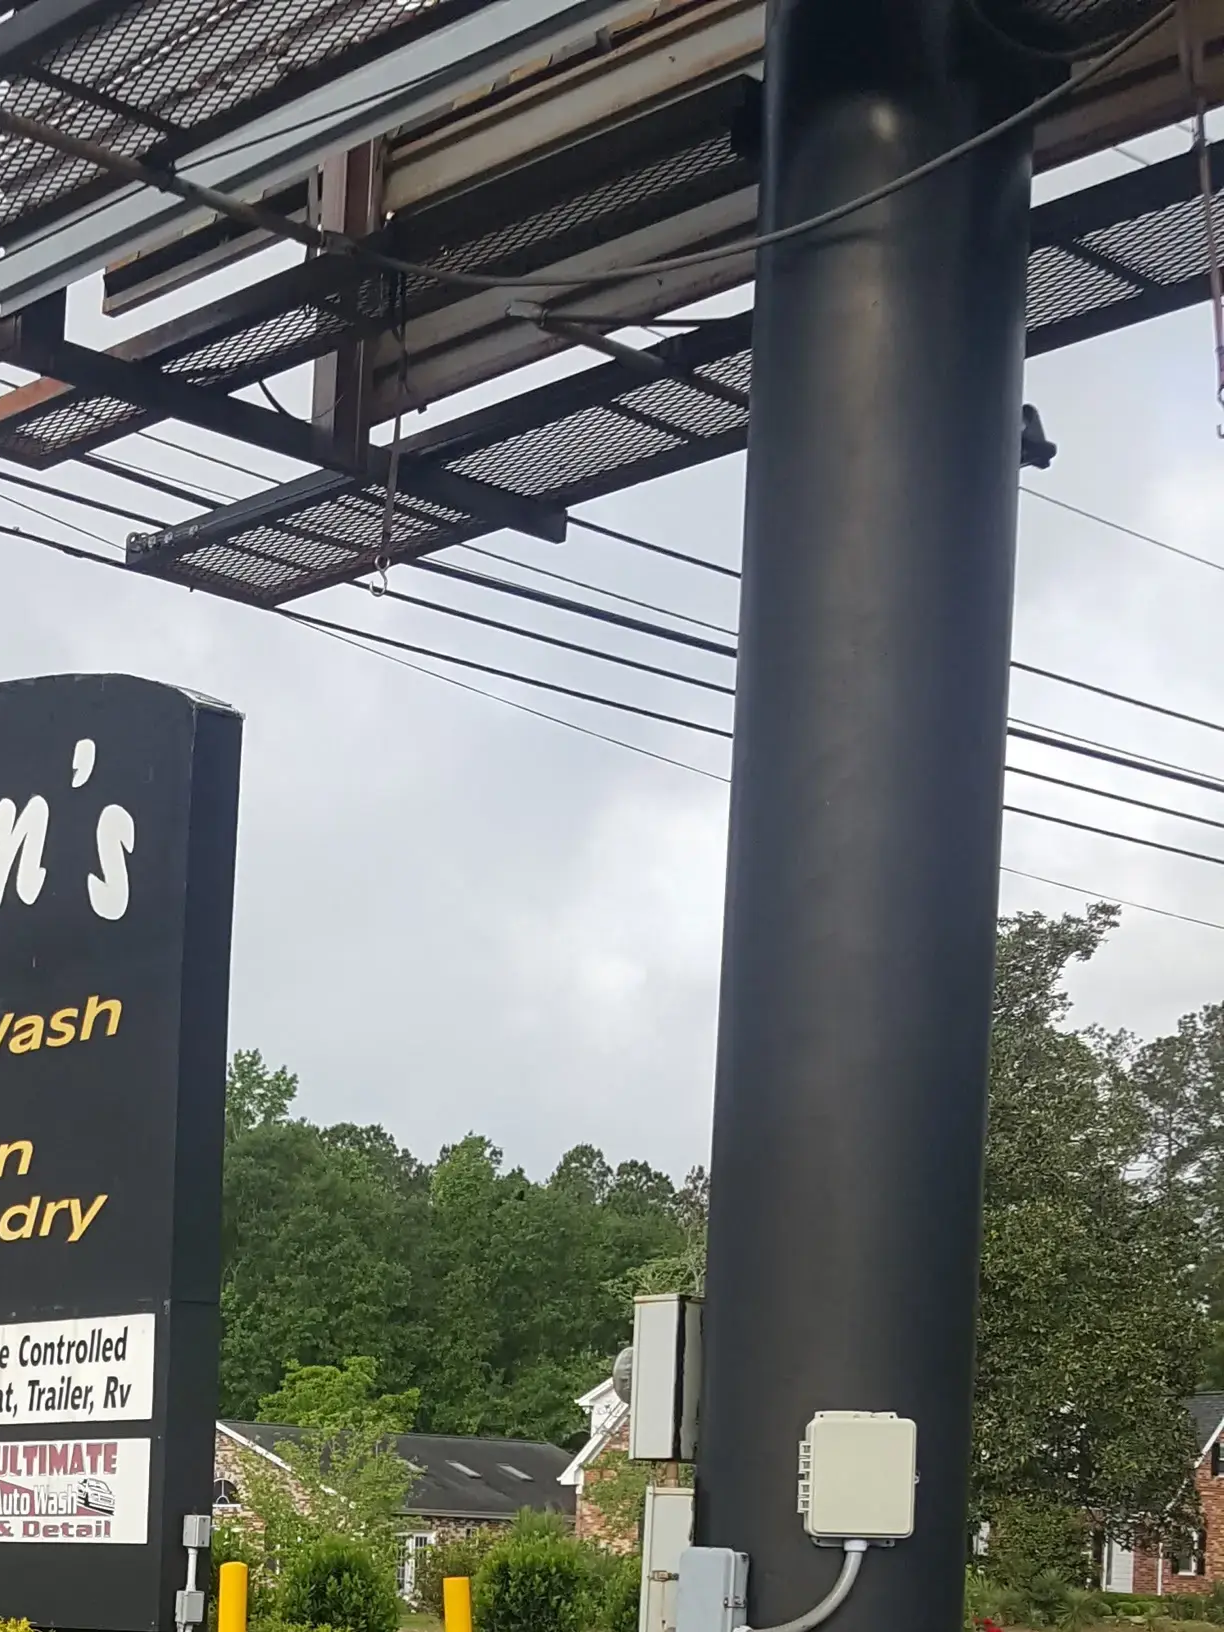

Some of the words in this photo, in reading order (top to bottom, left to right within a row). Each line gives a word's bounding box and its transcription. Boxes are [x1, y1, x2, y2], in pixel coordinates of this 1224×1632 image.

[19, 1326, 128, 1367] Controlled
[27, 1376, 94, 1414] Trailer,
[103, 1376, 132, 1408] Rv
[33, 1484, 77, 1515] Wash
[22, 1520, 111, 1538] Detail
